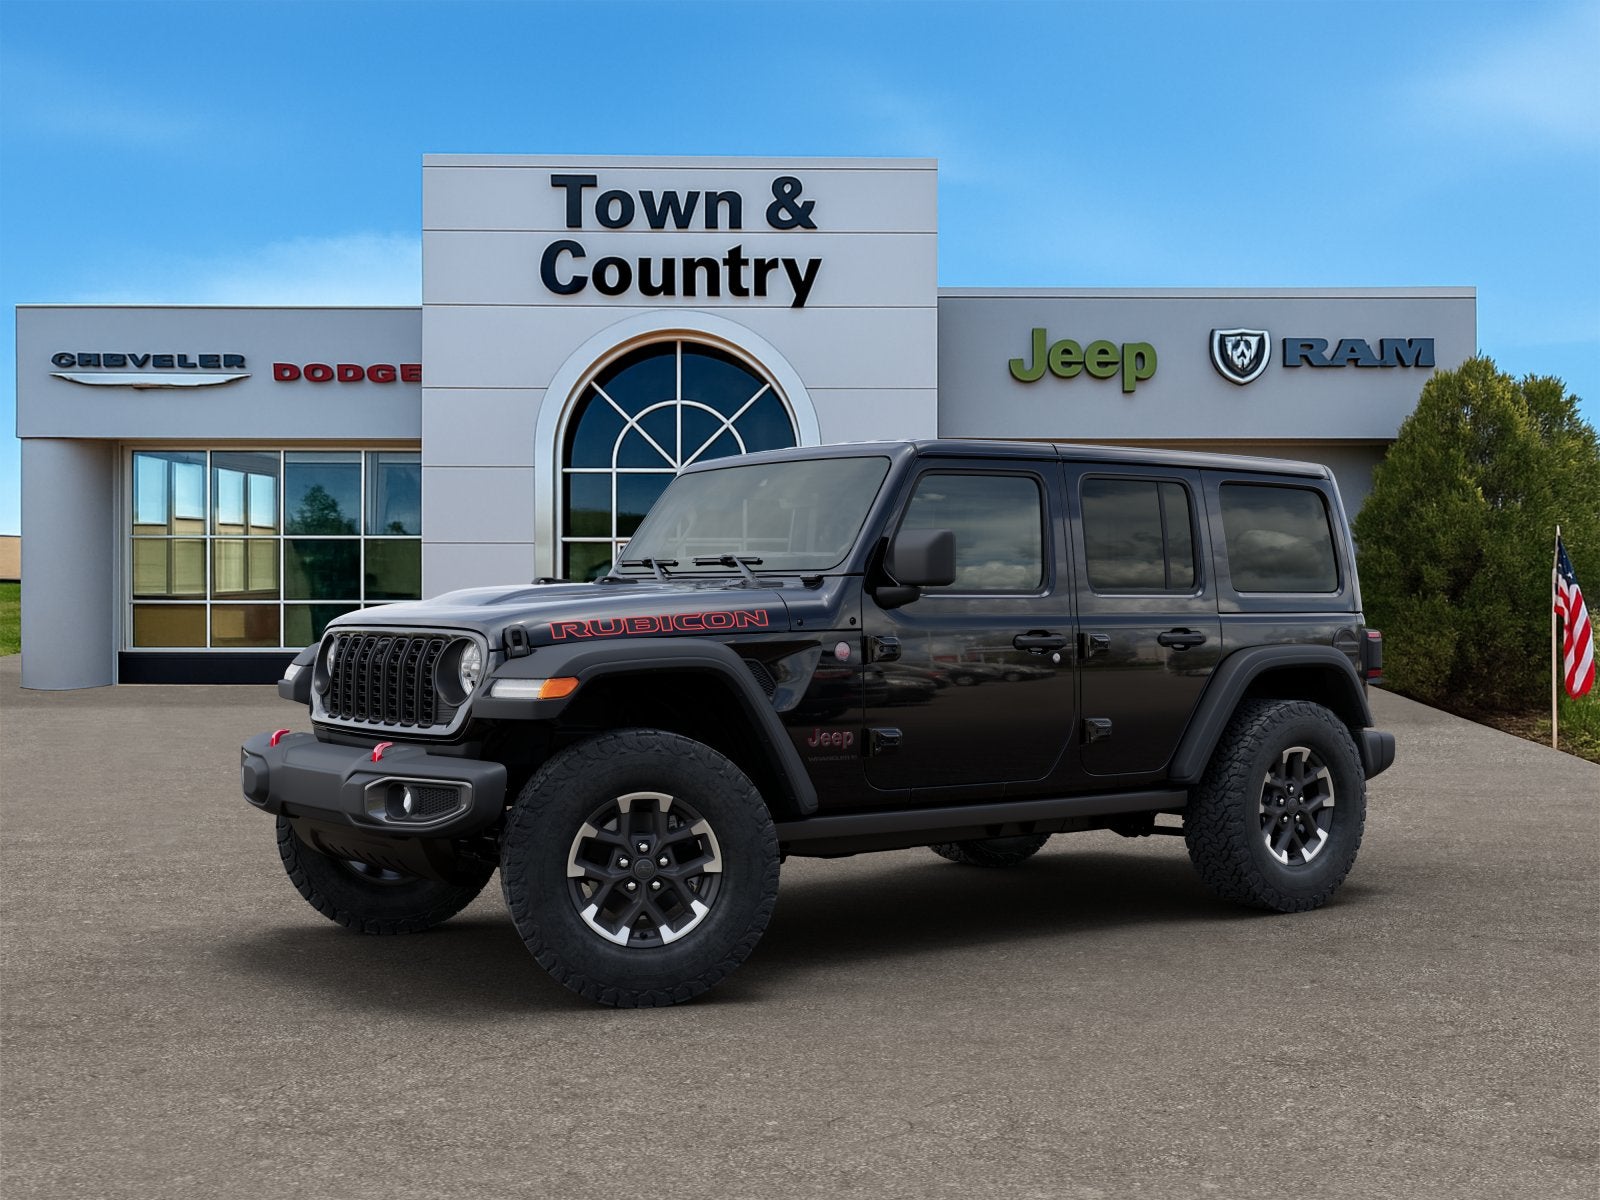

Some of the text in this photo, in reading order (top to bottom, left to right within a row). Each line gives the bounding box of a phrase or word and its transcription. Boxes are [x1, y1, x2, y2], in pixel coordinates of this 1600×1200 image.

[550, 174, 818, 229] Town &
[540, 239, 822, 308] Country
[1009, 328, 1157, 394] Jeep
[1283, 337, 1436, 368] RAM
[273, 363, 422, 382] DODGE
[550, 609, 769, 640] RUBICON
[808, 728, 854, 750] Jeep
